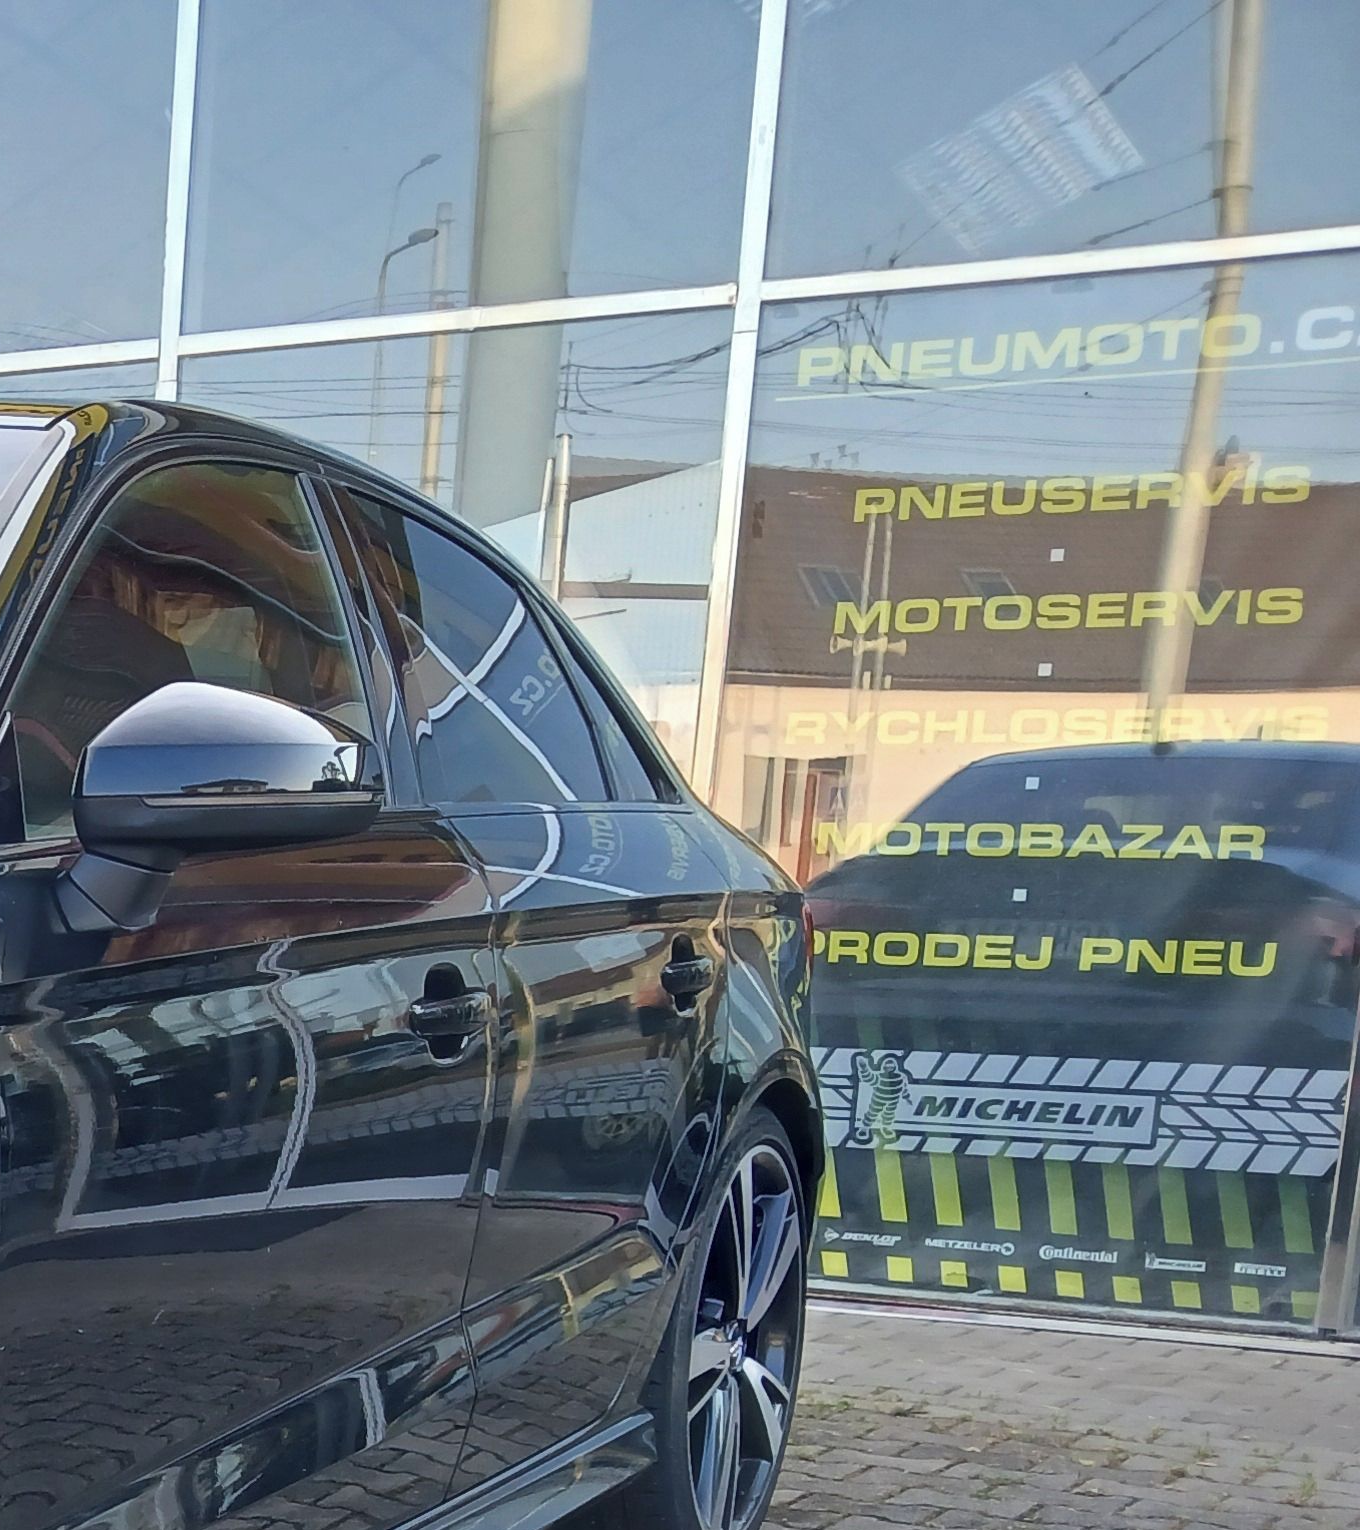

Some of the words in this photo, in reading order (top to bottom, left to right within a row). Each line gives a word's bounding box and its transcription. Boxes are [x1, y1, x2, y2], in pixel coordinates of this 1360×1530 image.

[796, 306, 1360, 387] PNEUMOTO.C
[853, 465, 1311, 522] PNEUSERVIS
[833, 587, 1304, 633] MOTOSERVIS
[785, 705, 1329, 745] RYCHLOSERVIS
[816, 823, 1266, 860] MOTOBAZAR
[1079, 938, 1278, 977] PNEU
[913, 1095, 1144, 1128] MICHELIN
